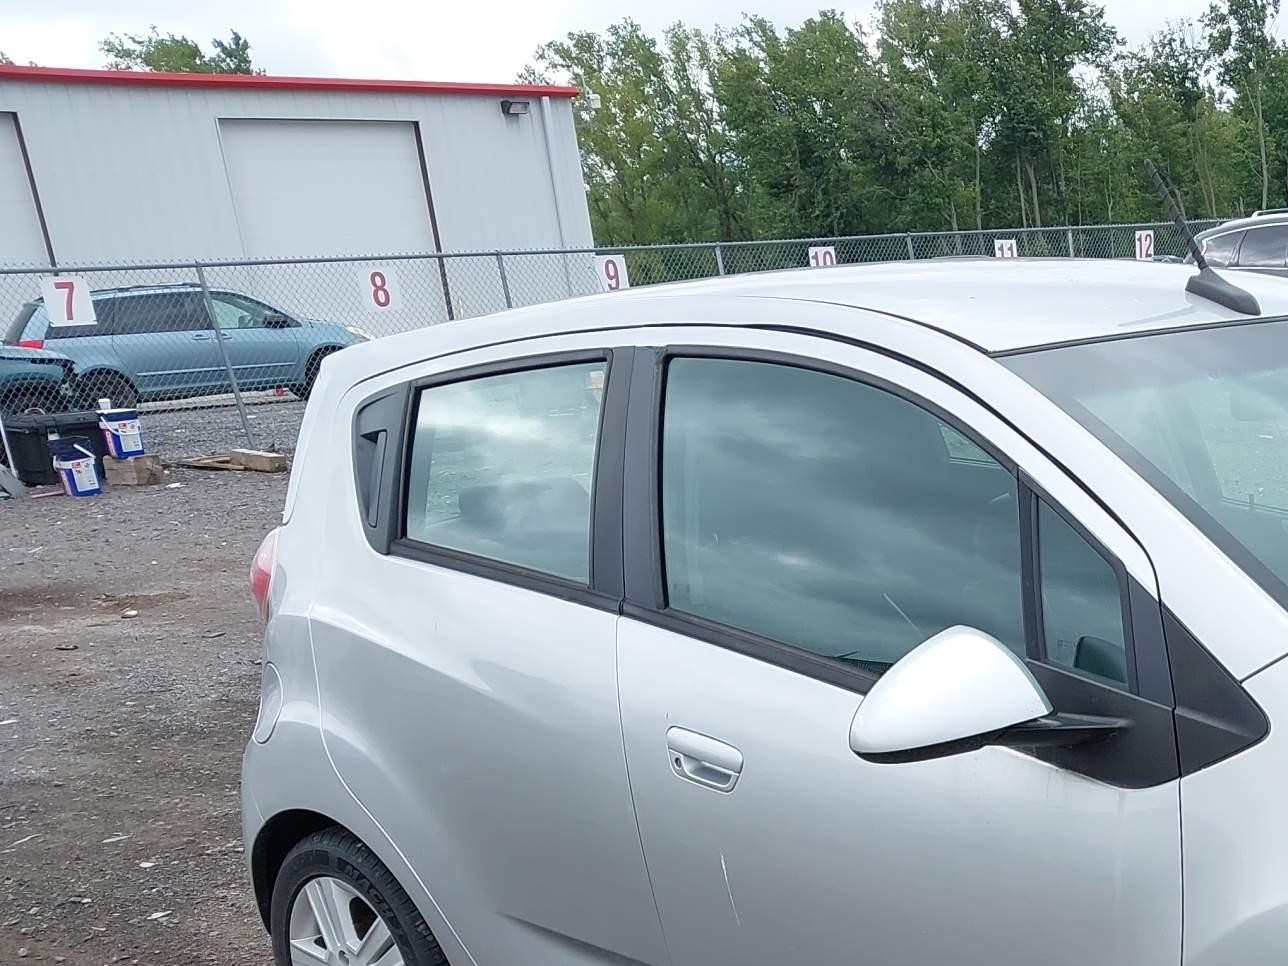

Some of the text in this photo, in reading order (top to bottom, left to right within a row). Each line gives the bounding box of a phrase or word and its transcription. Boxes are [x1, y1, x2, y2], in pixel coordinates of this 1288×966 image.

[811, 250, 834, 266] 10
[1137, 233, 1153, 259] 12
[370, 271, 390, 307] 8
[604, 259, 620, 290] 9
[53, 281, 75, 321] 7
